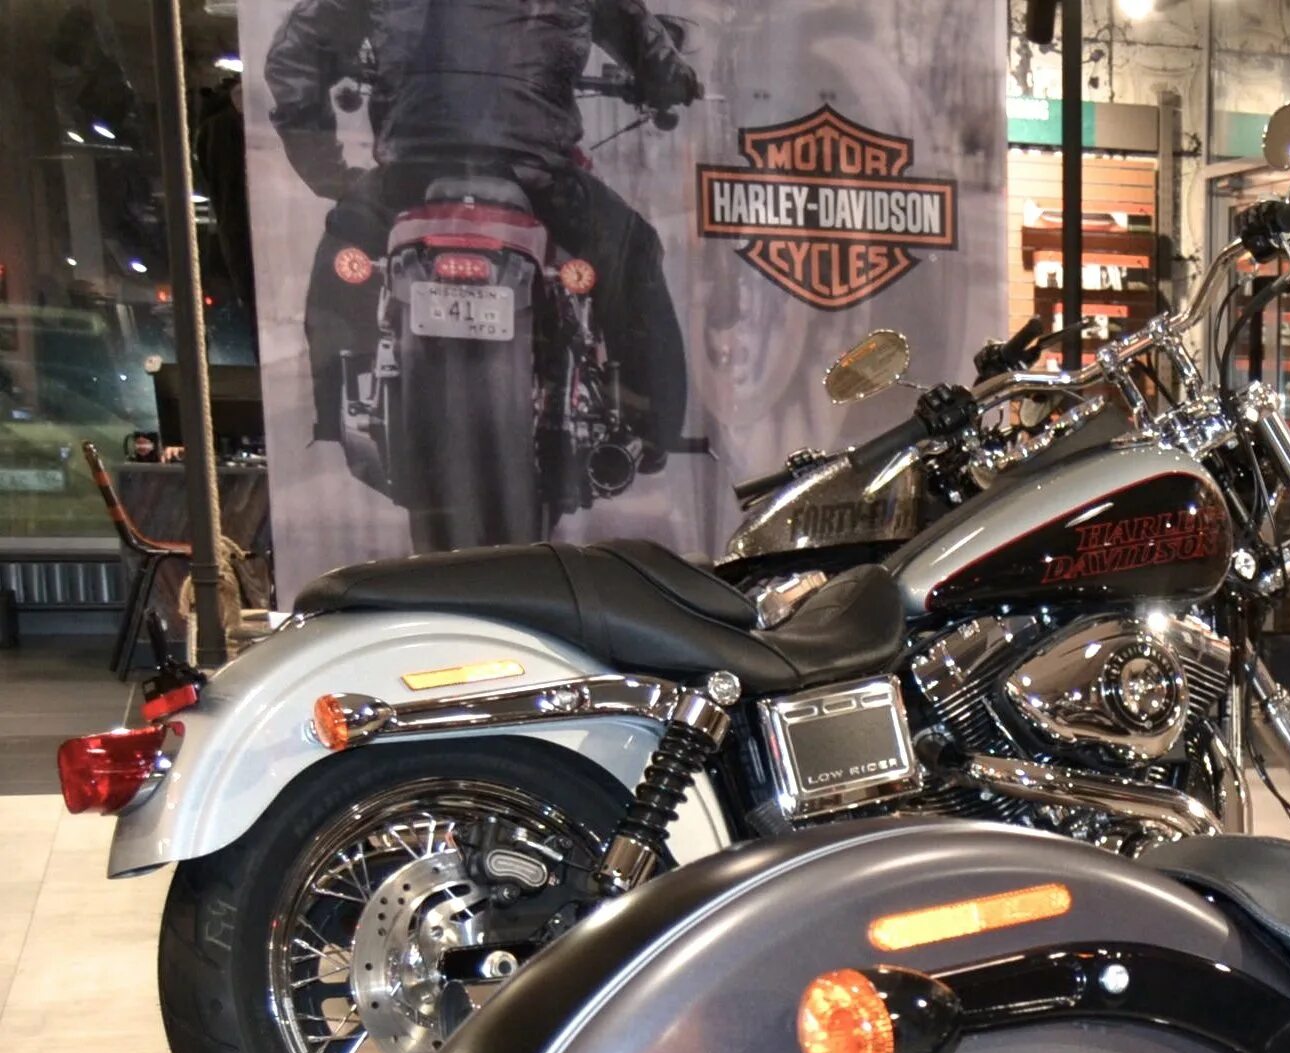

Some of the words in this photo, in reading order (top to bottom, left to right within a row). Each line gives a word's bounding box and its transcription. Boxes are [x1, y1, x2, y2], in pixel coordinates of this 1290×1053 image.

[768, 125, 887, 175] MOTOR
[713, 181, 941, 234] HARLEY-DAVIDSON
[768, 240, 888, 296] CYCLES
[449, 301, 474, 321] 41
[1041, 533, 1217, 584] DAVIDSON
[807, 769, 844, 785] LOW
[849, 757, 899, 776] RIDER
